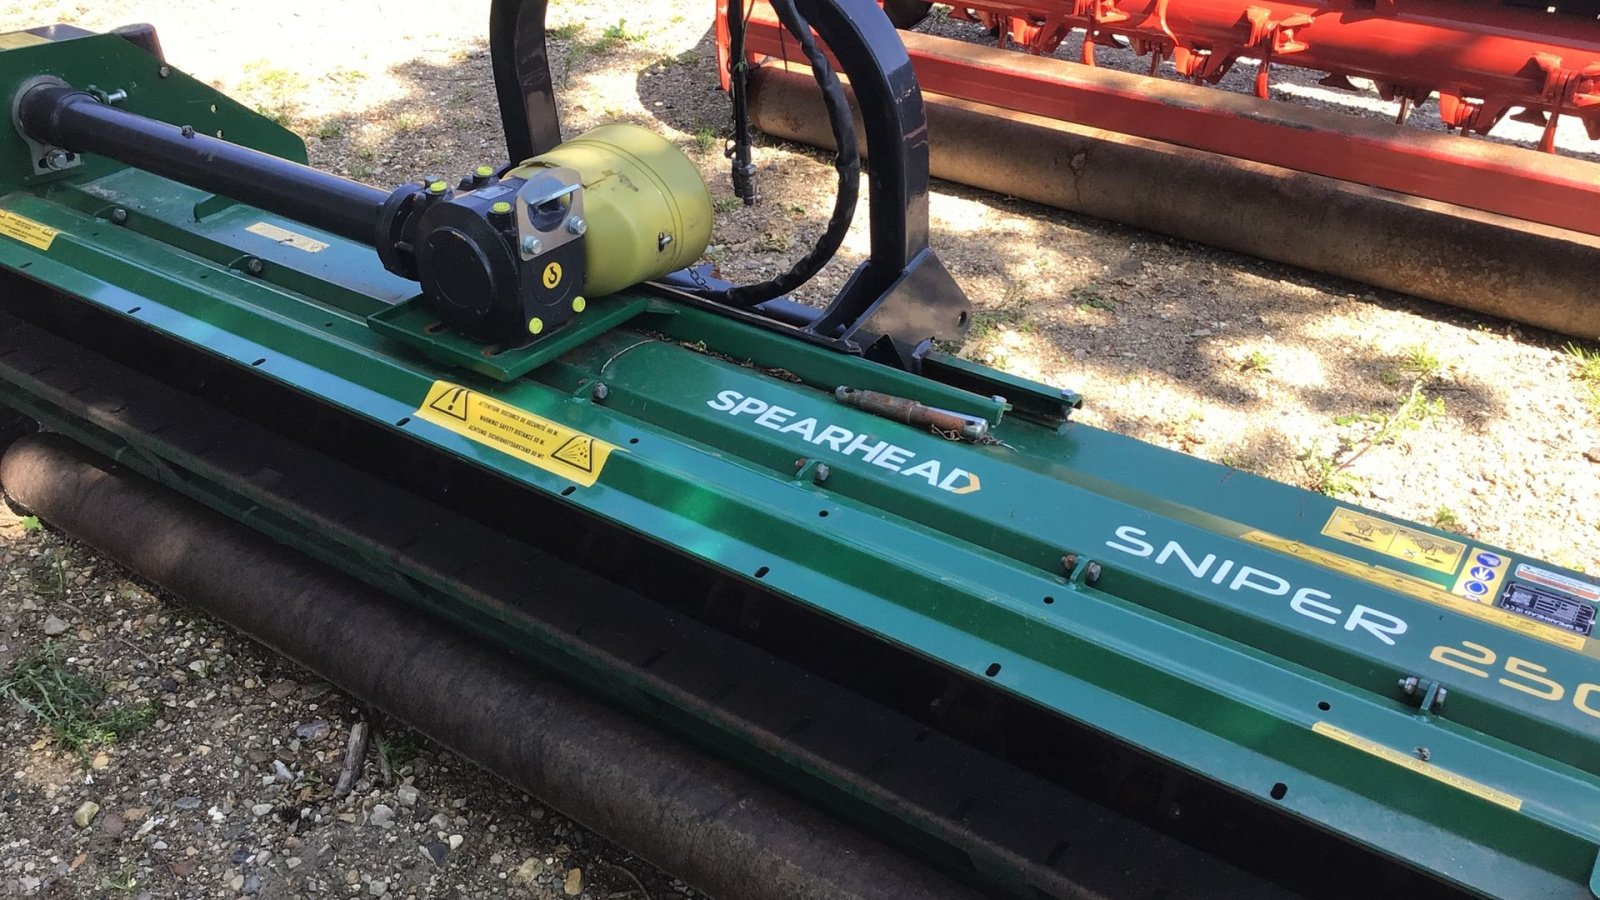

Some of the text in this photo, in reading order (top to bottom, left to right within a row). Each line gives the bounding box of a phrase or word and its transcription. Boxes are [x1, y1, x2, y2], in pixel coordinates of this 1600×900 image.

[499, 423, 514, 432] SAFETY
[514, 428, 534, 441] DISTANCE
[501, 410, 520, 421] DISTANCE
[707, 390, 980, 494] SPEARHEAD
[1105, 525, 1408, 645] SNIPER
